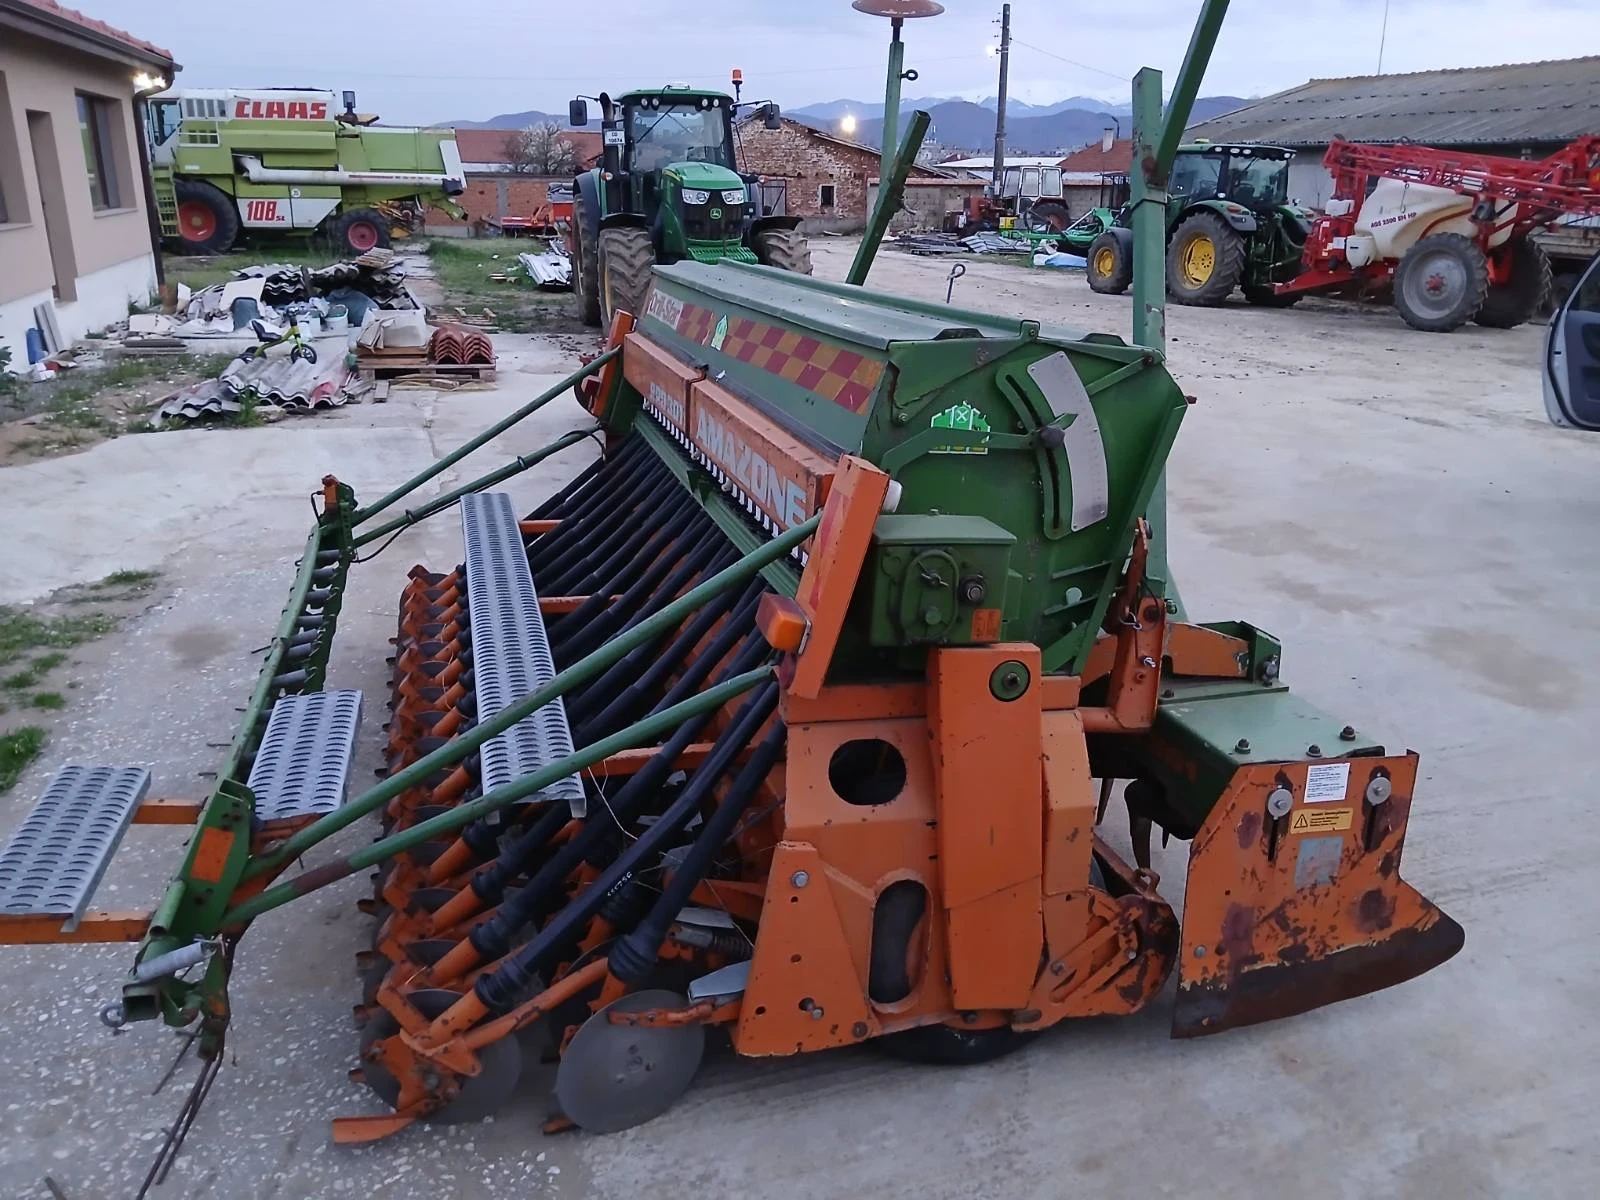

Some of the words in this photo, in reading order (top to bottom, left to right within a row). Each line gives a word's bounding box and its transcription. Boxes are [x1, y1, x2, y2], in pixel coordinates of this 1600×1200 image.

[235, 101, 326, 119] CLAAS
[247, 201, 277, 221] 108
[696, 407, 806, 529] AMAZONE
